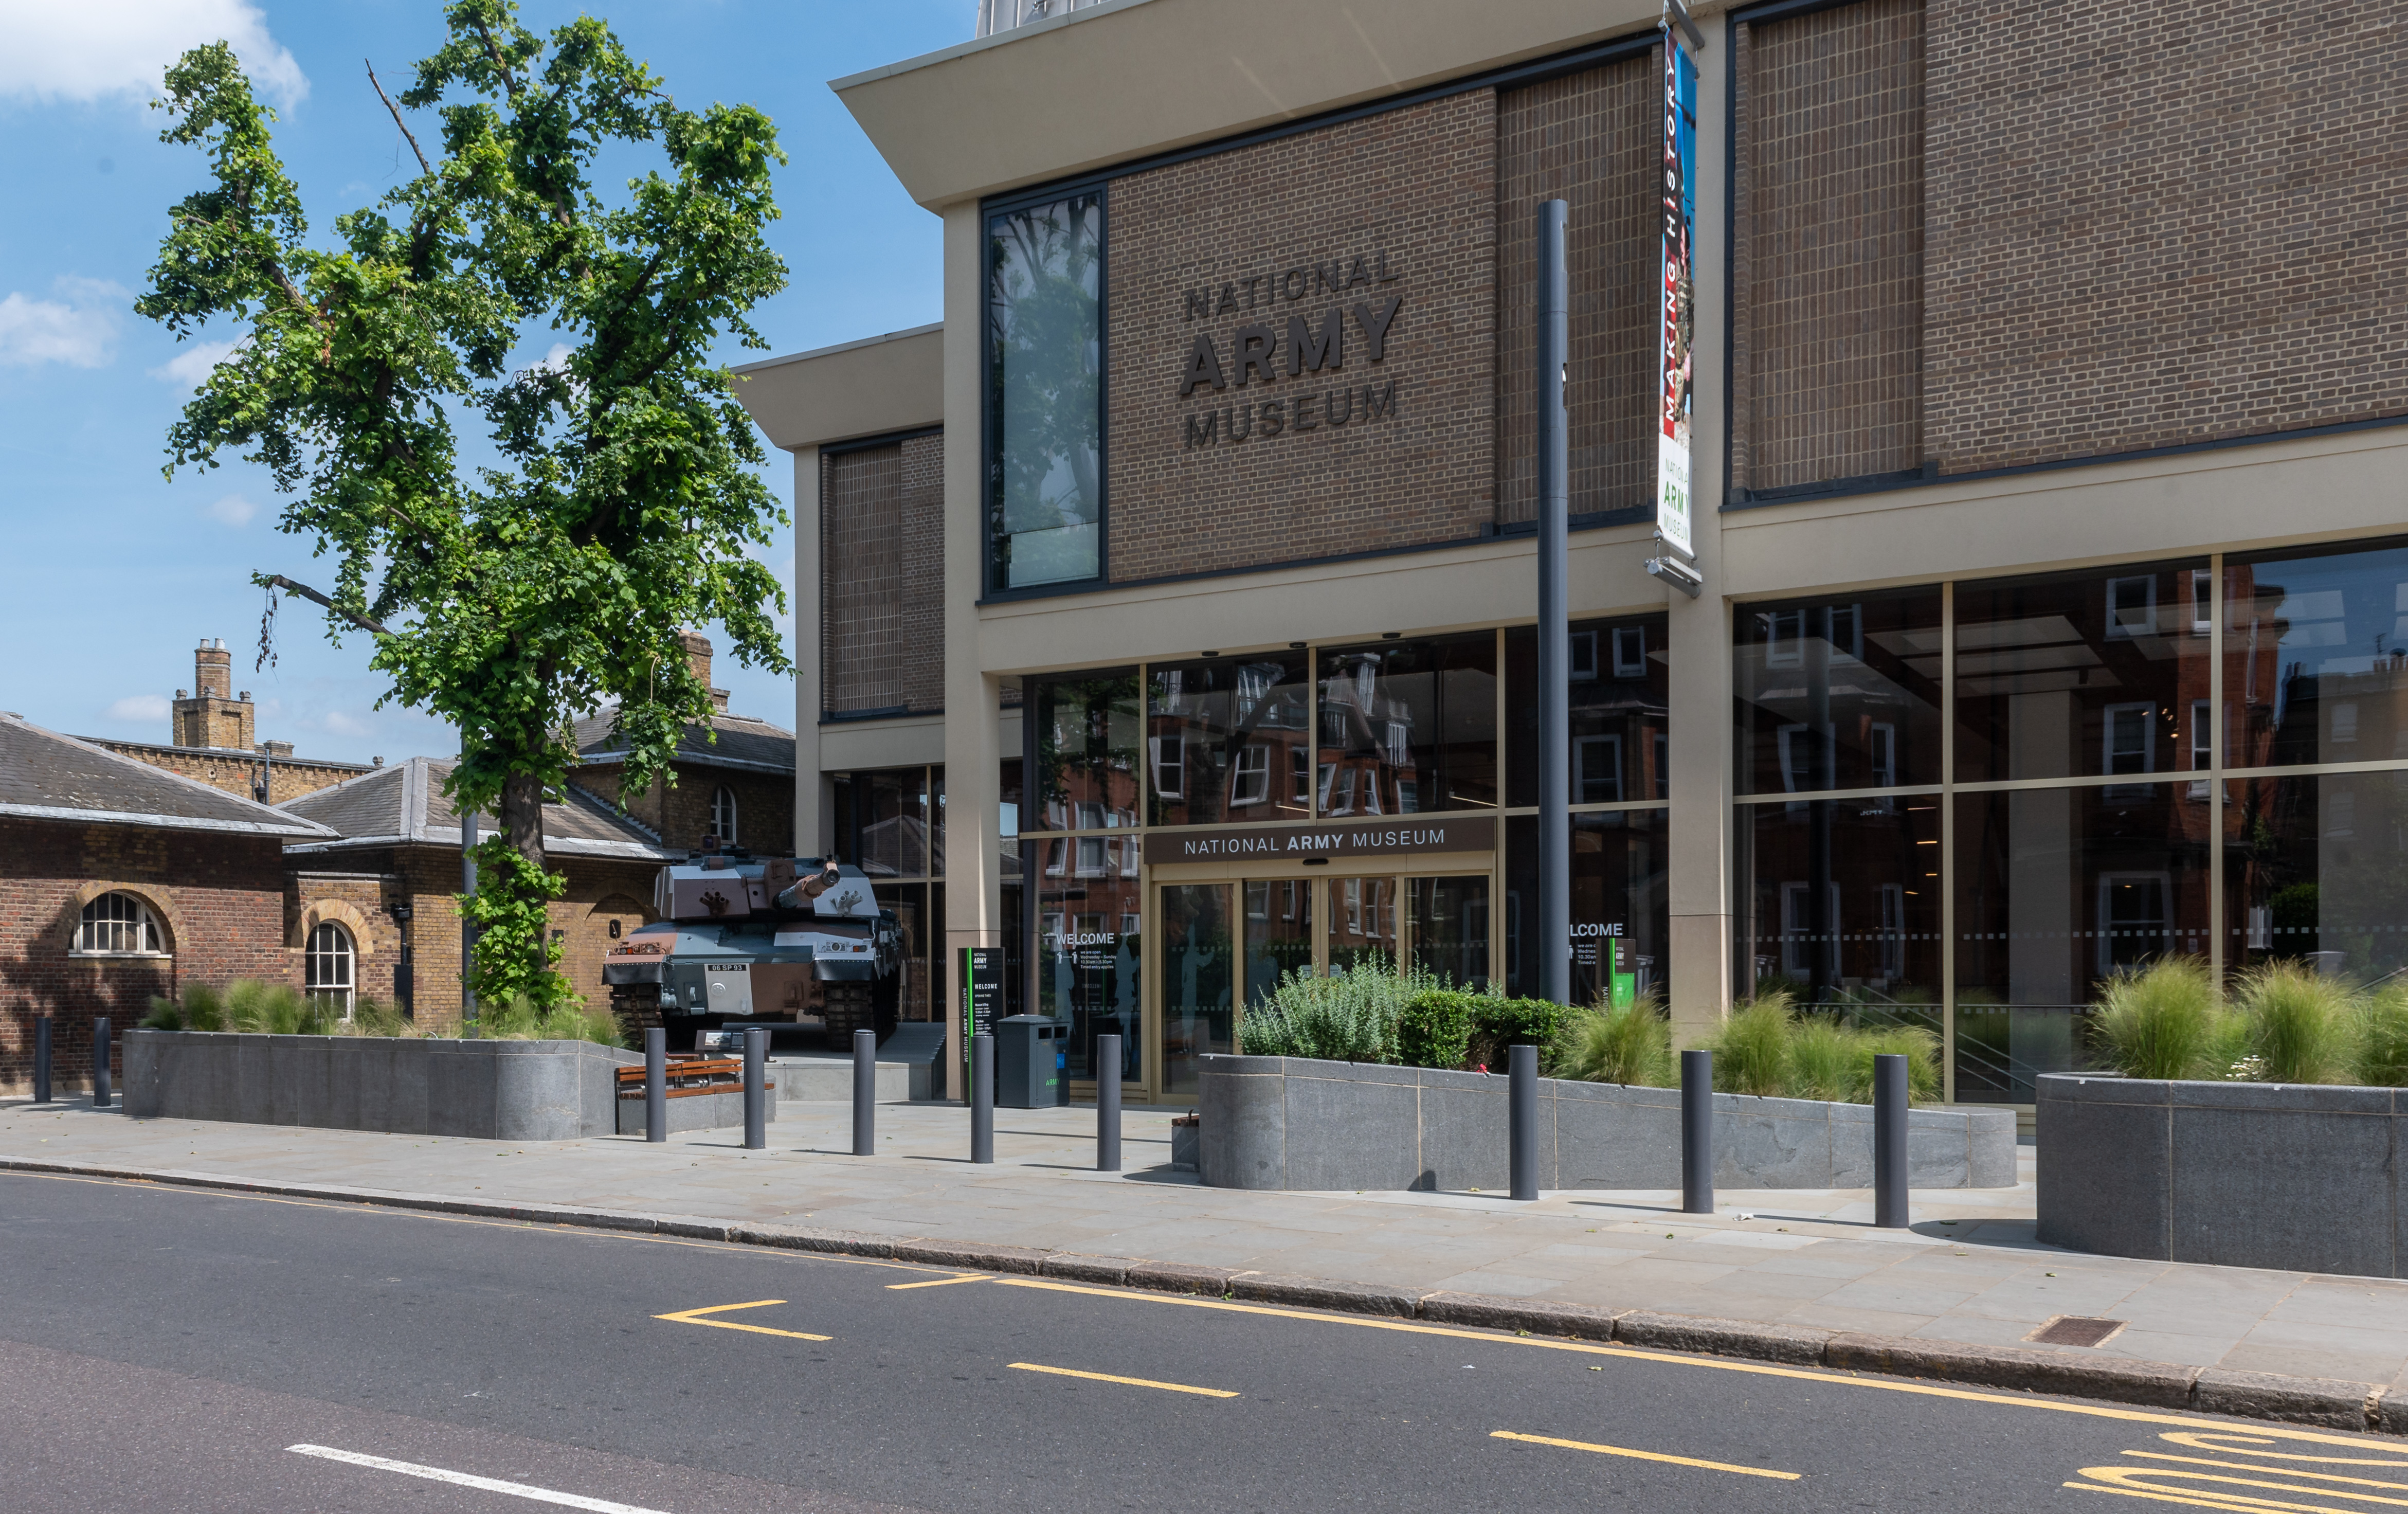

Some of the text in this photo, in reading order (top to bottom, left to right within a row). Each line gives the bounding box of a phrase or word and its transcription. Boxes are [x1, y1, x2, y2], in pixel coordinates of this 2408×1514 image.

[1666, 56, 1675, 421] MAKING HISTORY
[1187, 249, 1398, 321] NATIONAL
[1181, 296, 1403, 395] ARMY
[1186, 380, 1395, 448] MUSEUM
[1665, 458, 1688, 485] NATIONA
[1185, 829, 1444, 854] NATIONAL ARMY MUSEUM
[1056, 933, 1114, 944] WELCOME
[1570, 923, 1623, 936] LCOME
